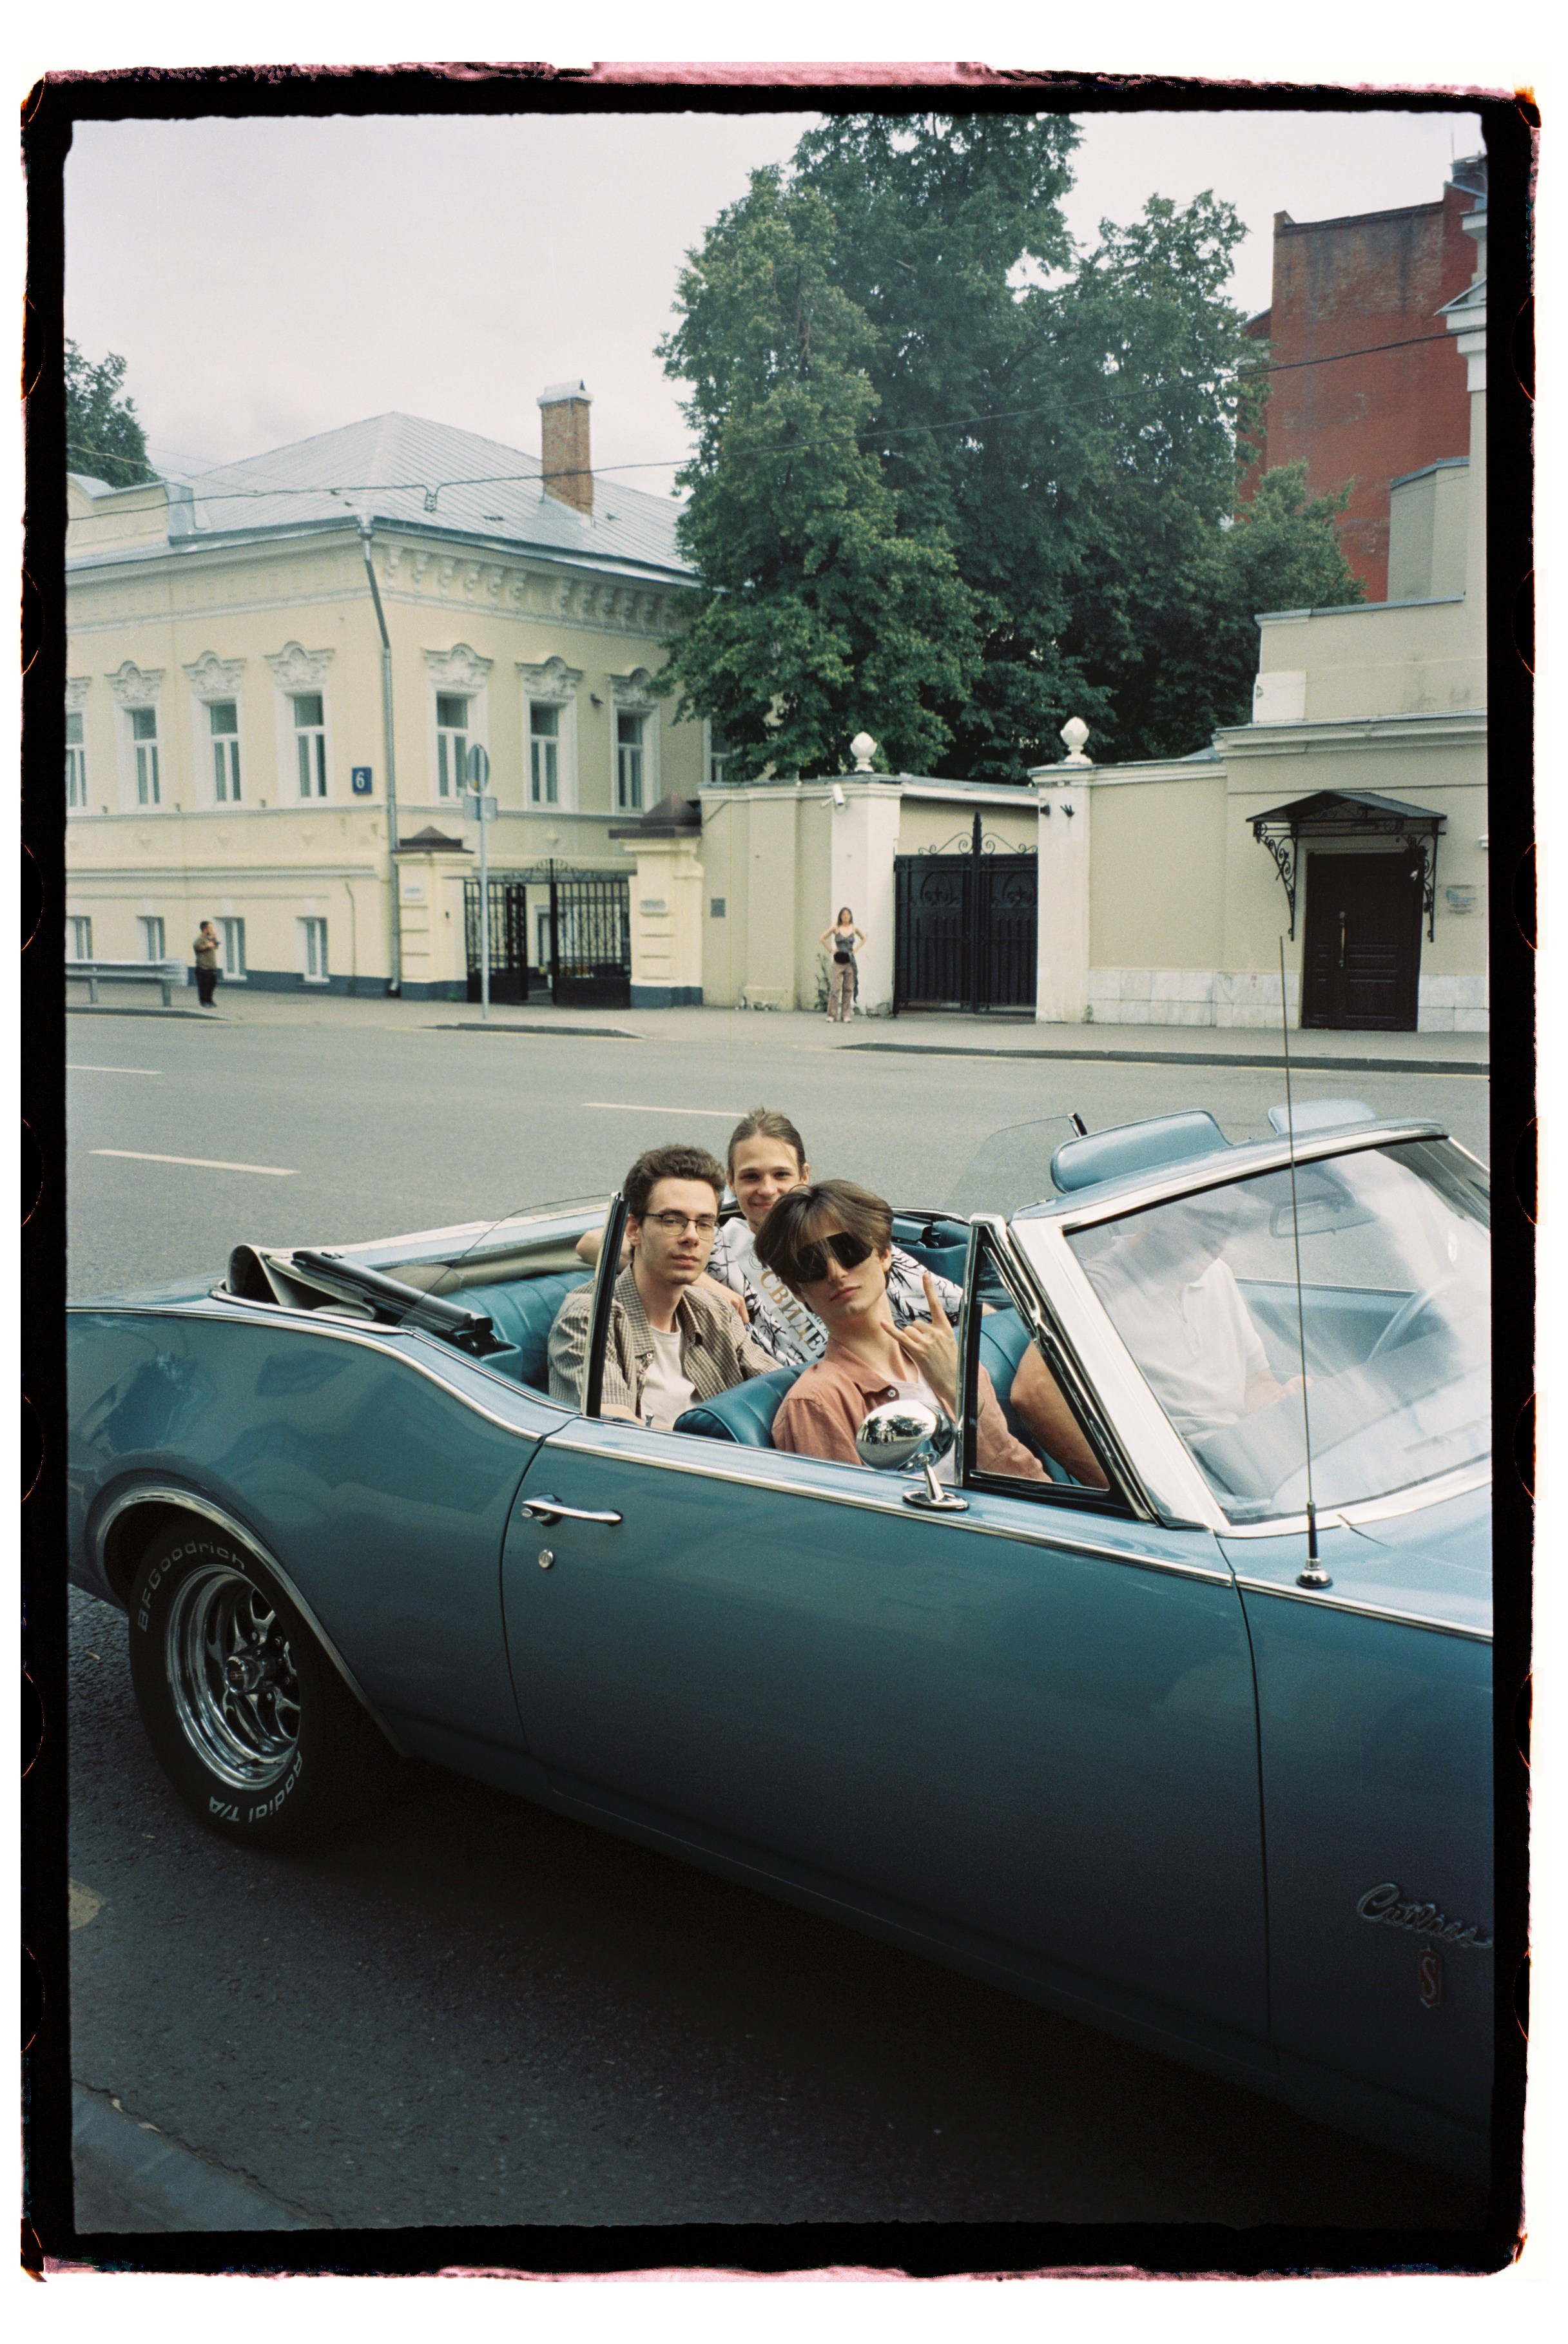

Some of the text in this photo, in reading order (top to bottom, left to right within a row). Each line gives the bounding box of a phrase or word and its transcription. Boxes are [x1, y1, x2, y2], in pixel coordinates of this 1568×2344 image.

[356, 771, 365, 789] 6
[760, 1270, 828, 1359] СВИДЕ
[137, 1541, 245, 1632] BFGoodrich
[209, 1750, 304, 1823] Radial T/A
